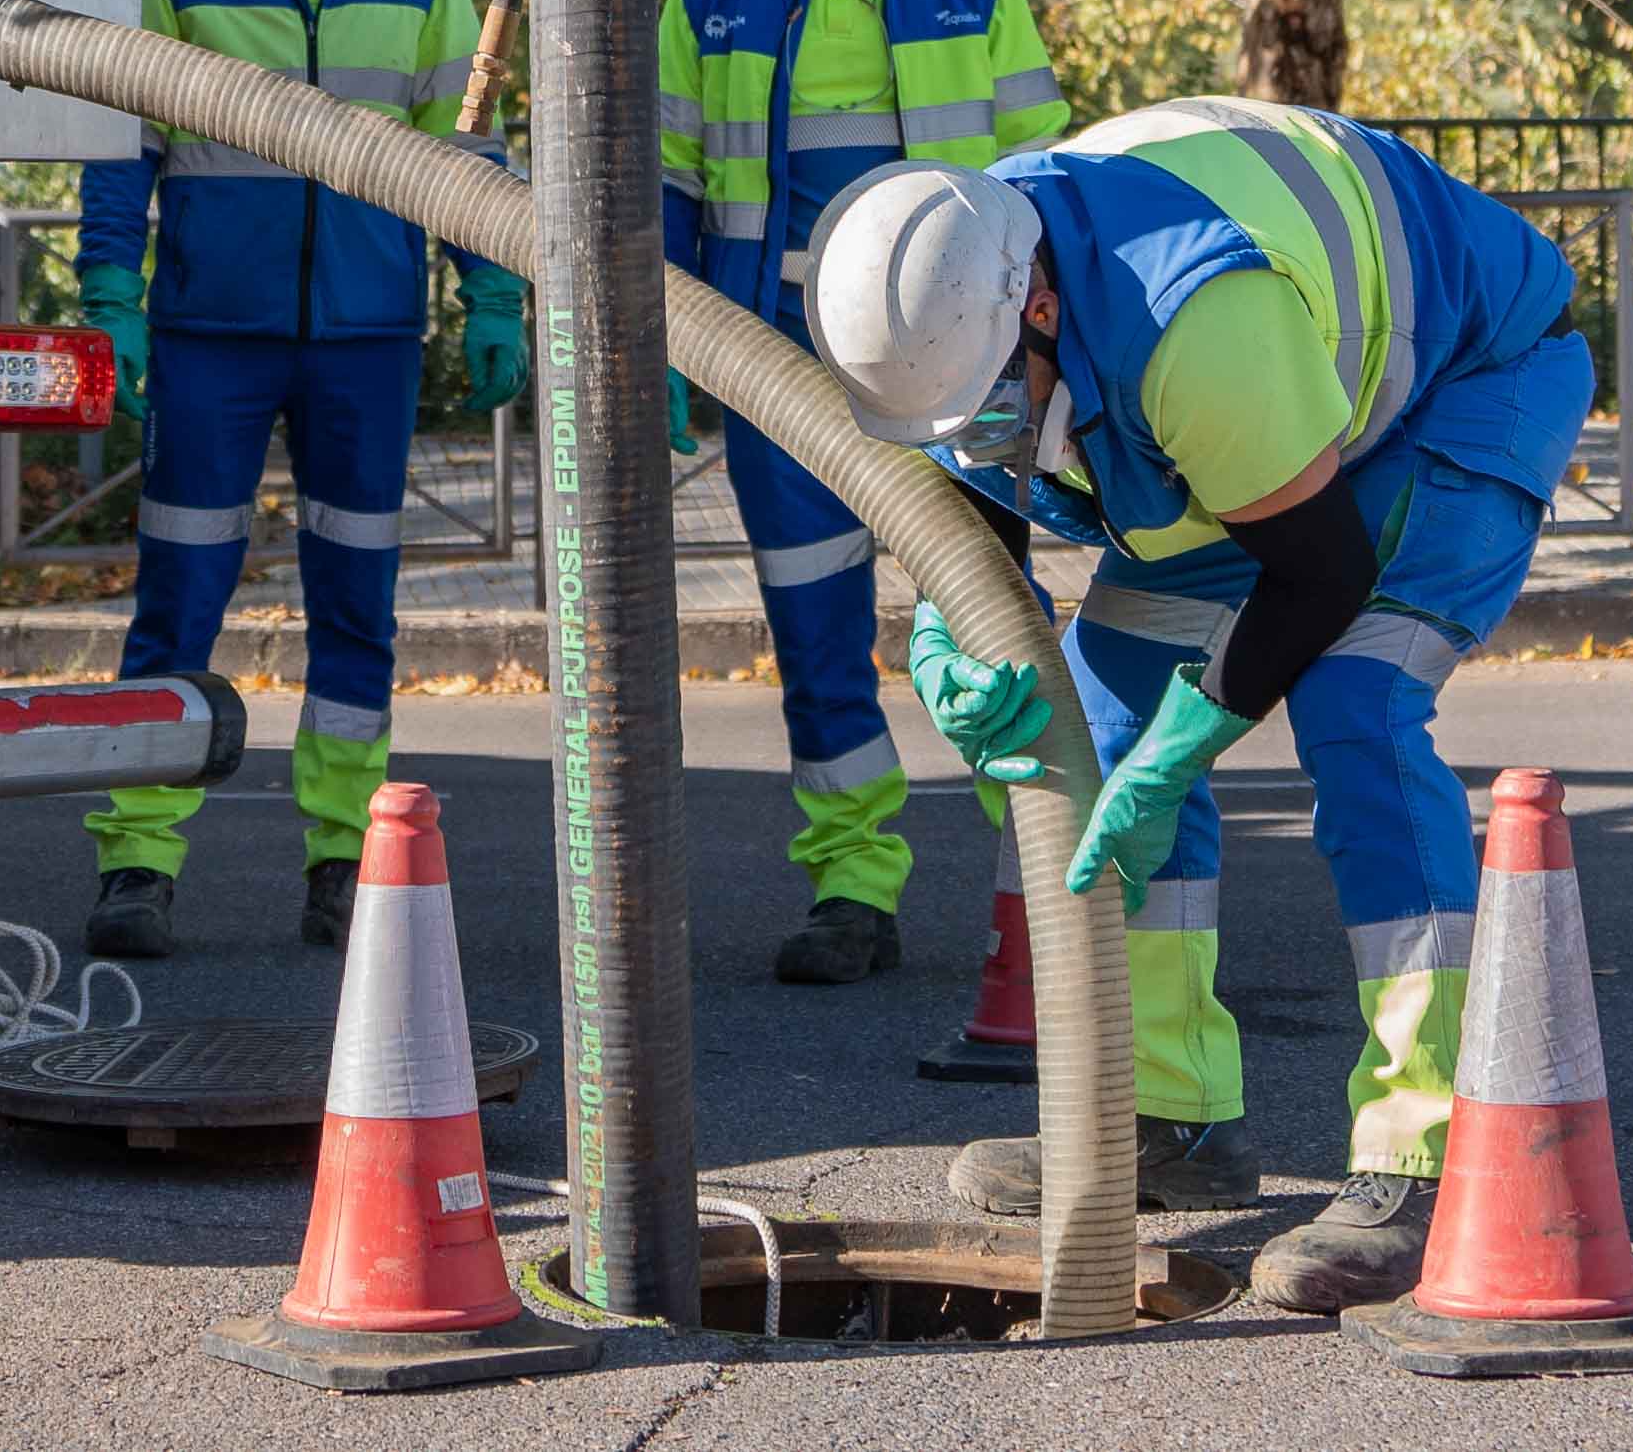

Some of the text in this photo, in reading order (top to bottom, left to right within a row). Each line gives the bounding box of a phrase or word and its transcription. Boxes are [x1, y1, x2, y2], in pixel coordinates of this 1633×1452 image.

[551, 387, 579, 493] EPDM
[557, 527, 587, 698] PURPOSE
[565, 709, 594, 876] GENERAL
[572, 884, 596, 934] psi)
[573, 942, 600, 1010] (150
[578, 1019, 602, 1075] bar
[580, 1081, 603, 1119] 10
